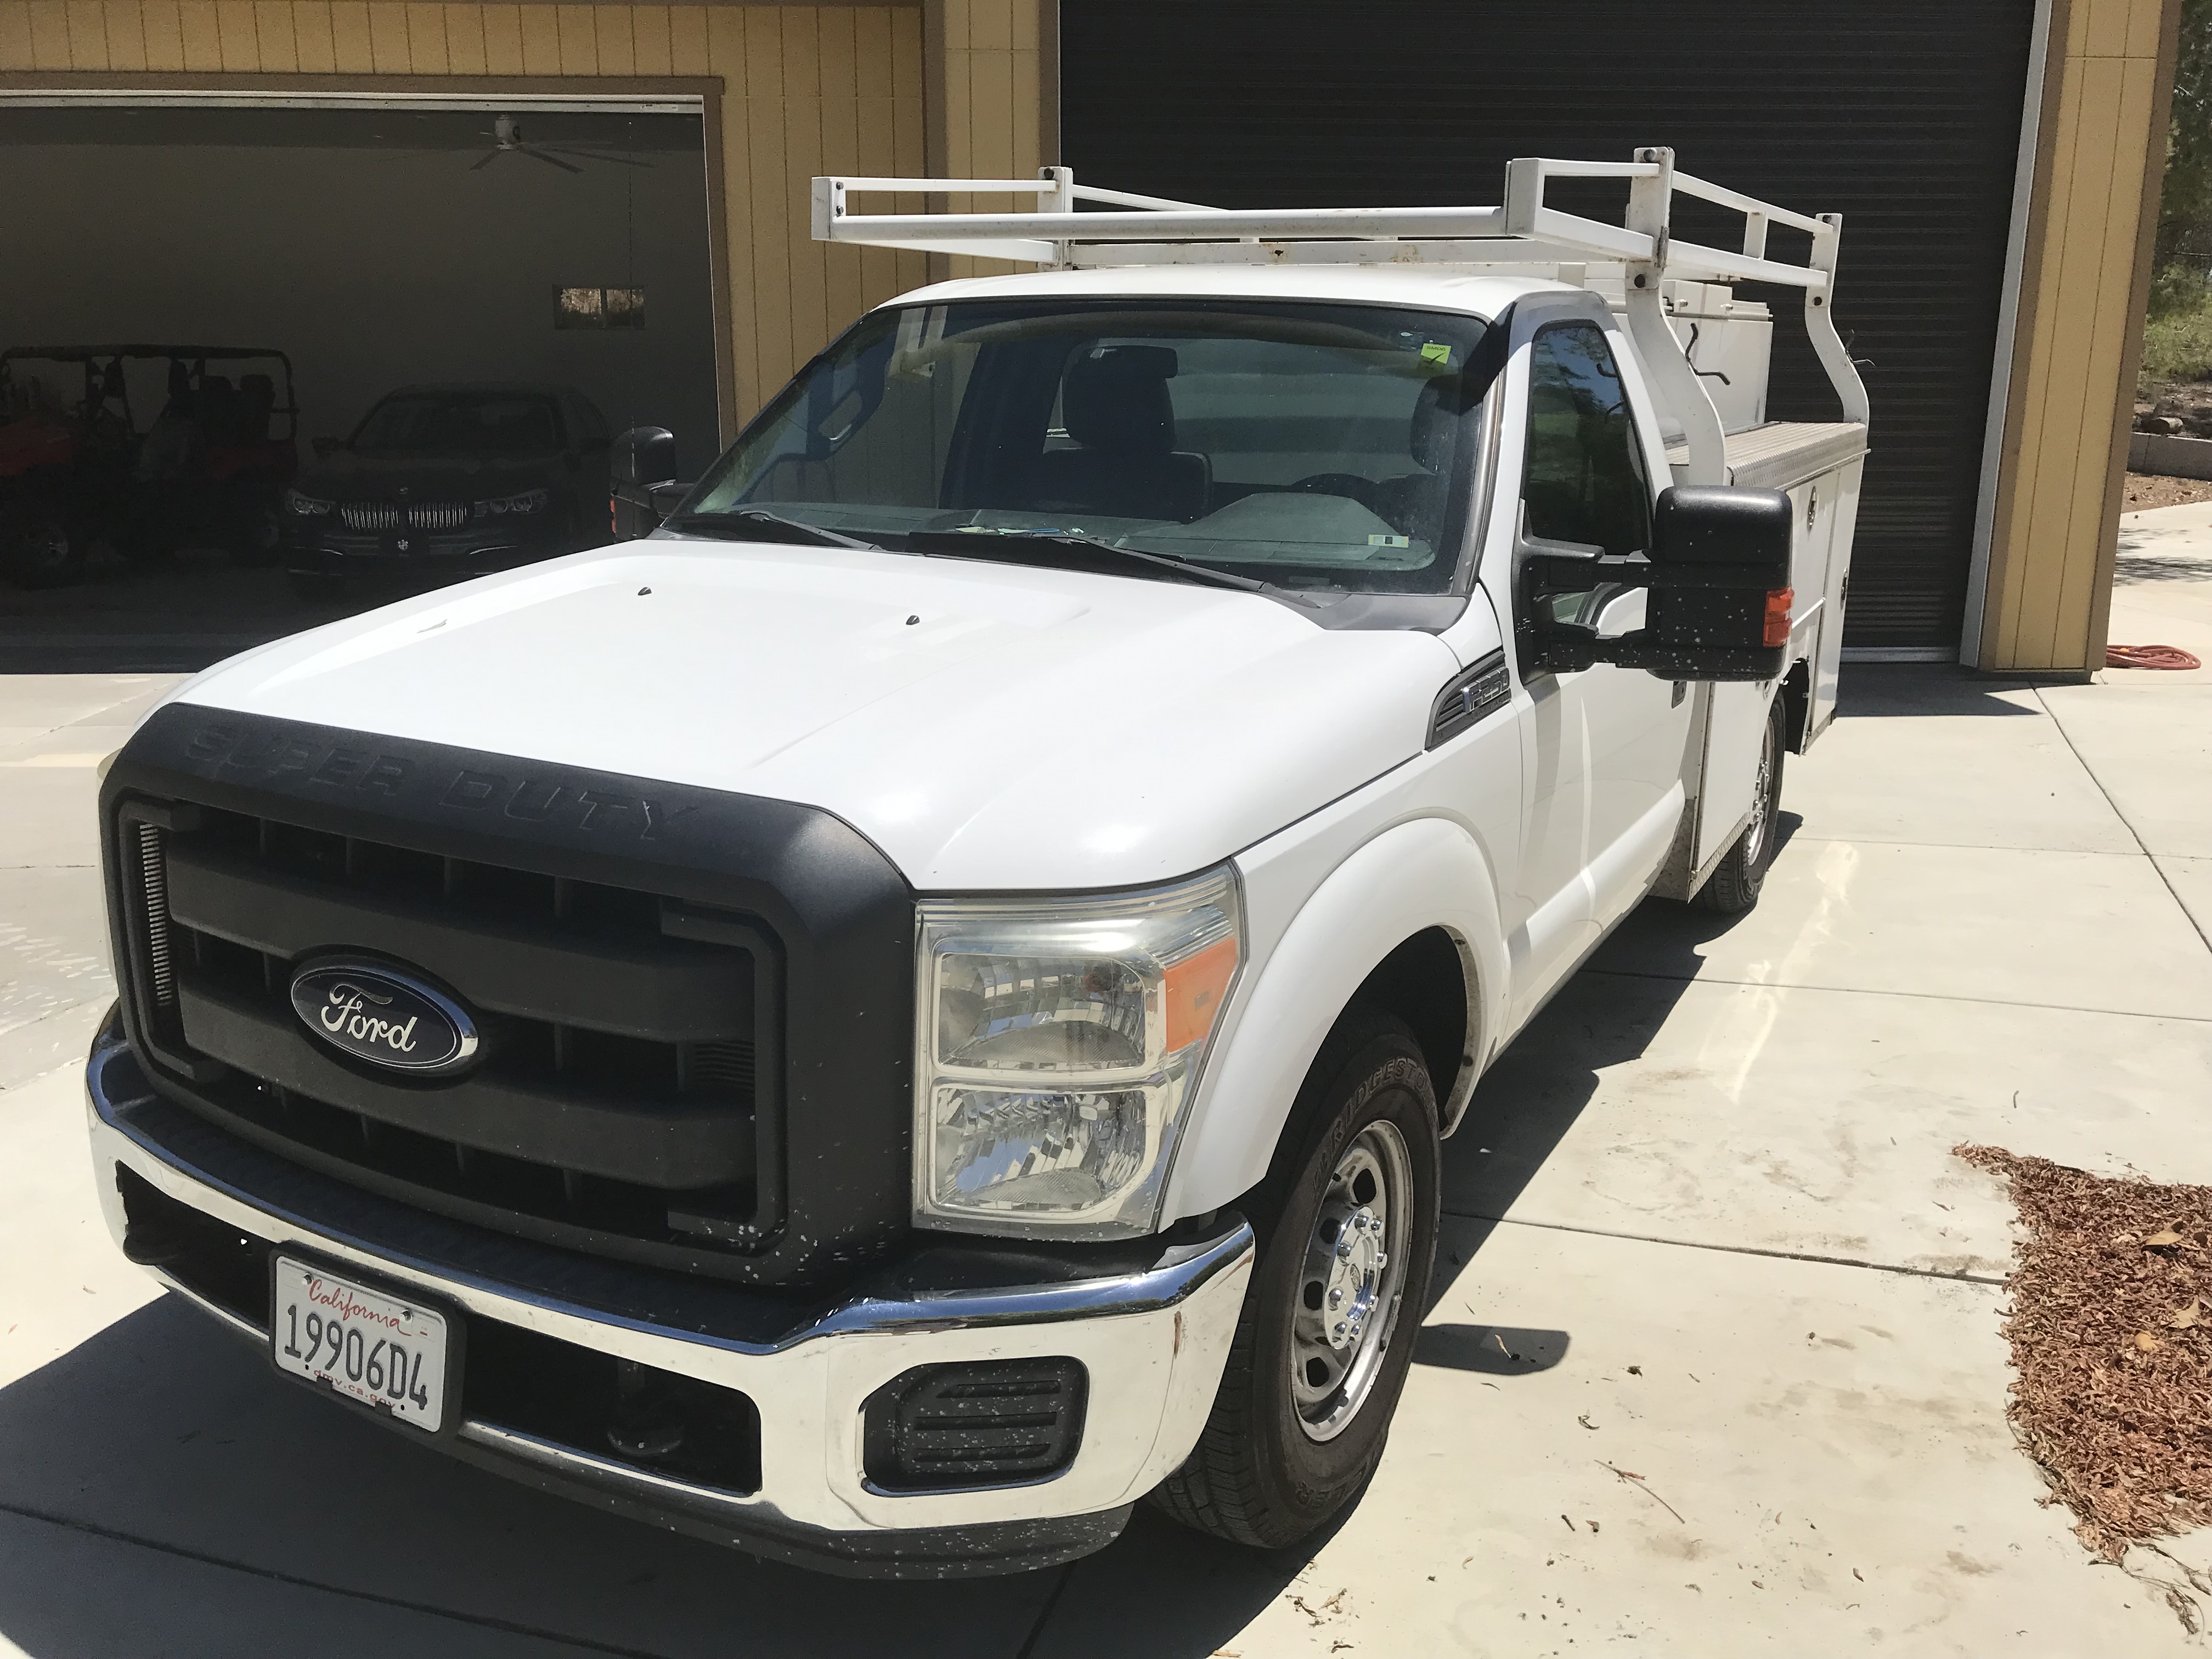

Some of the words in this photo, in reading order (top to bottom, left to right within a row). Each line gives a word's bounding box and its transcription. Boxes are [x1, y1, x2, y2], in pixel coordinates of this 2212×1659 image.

[185, 726, 417, 797] SUPER
[439, 770, 698, 840] DUTY
[321, 983, 417, 1052] Ford
[309, 1279, 412, 1336] California
[284, 1304, 428, 1411] 19906D4
[313, 1369, 396, 1408] dmv.ca.gov
